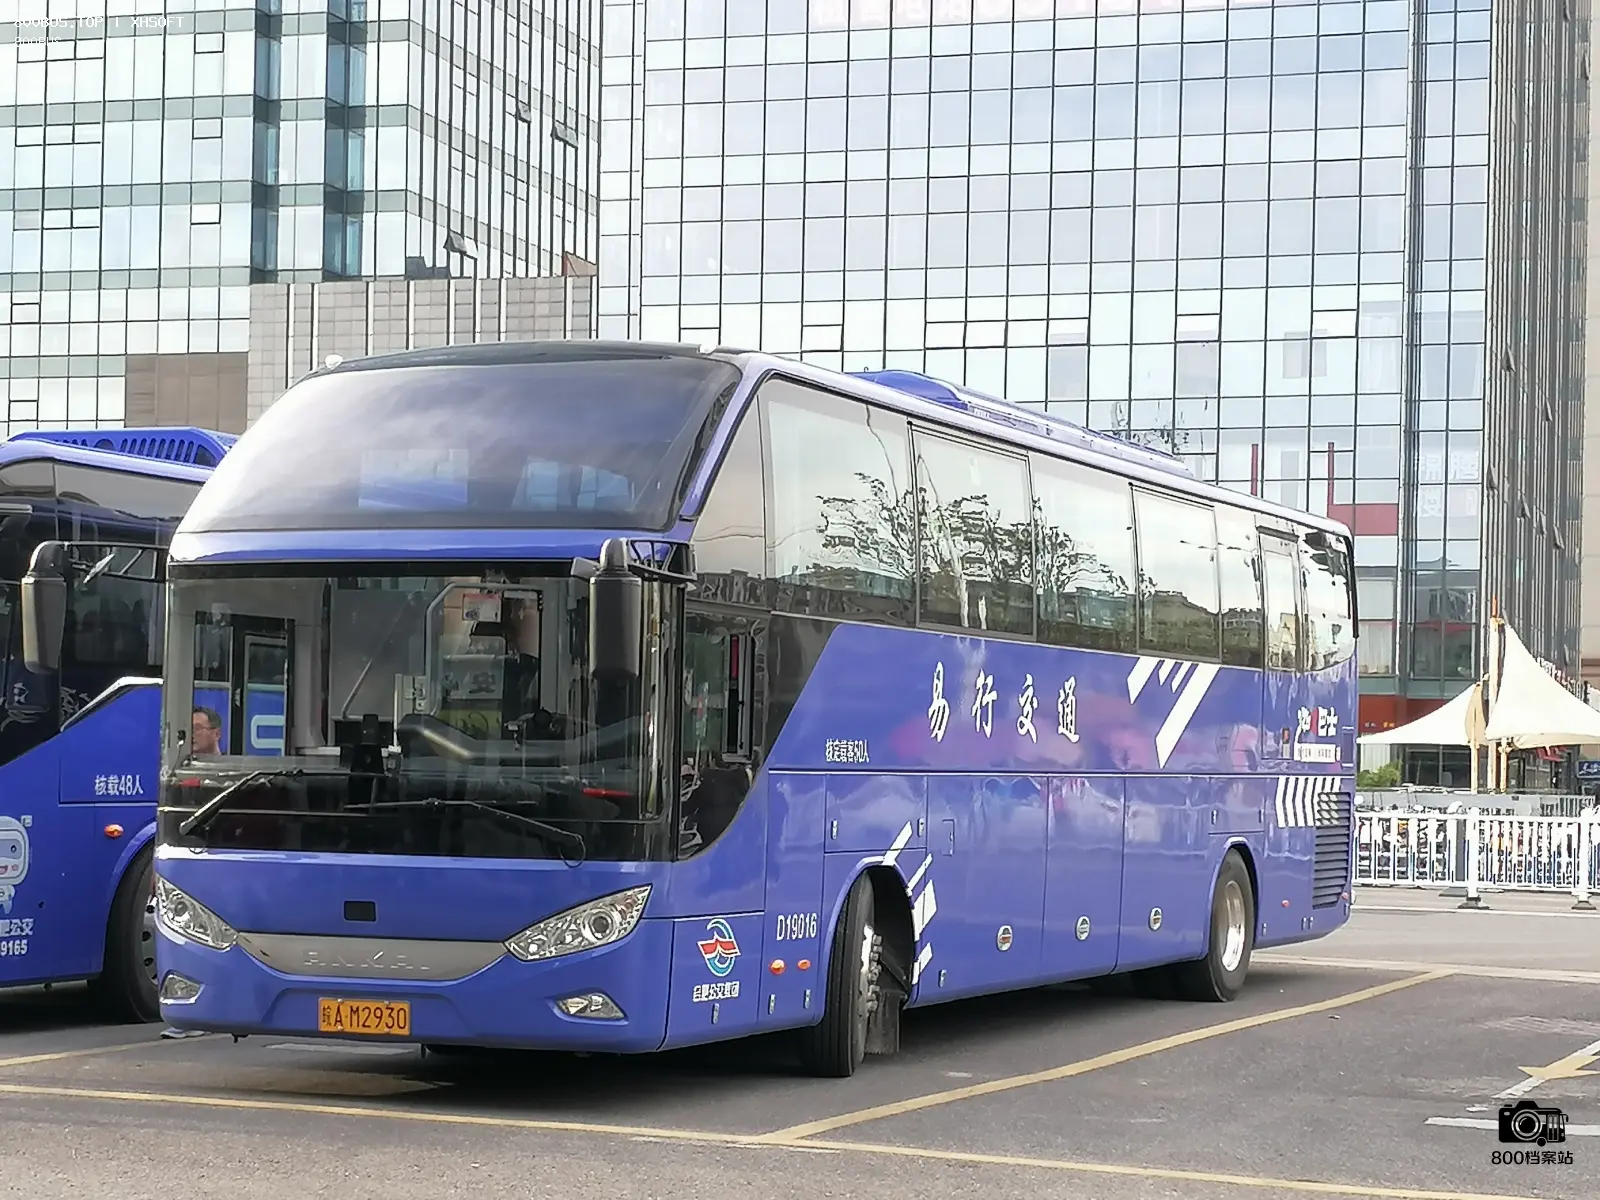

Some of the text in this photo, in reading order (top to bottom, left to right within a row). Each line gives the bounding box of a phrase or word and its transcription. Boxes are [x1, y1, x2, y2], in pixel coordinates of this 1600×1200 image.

[928, 661, 1080, 744] 易行交通
[94, 774, 144, 796] 核载48人
[776, 912, 818, 941] D19016
